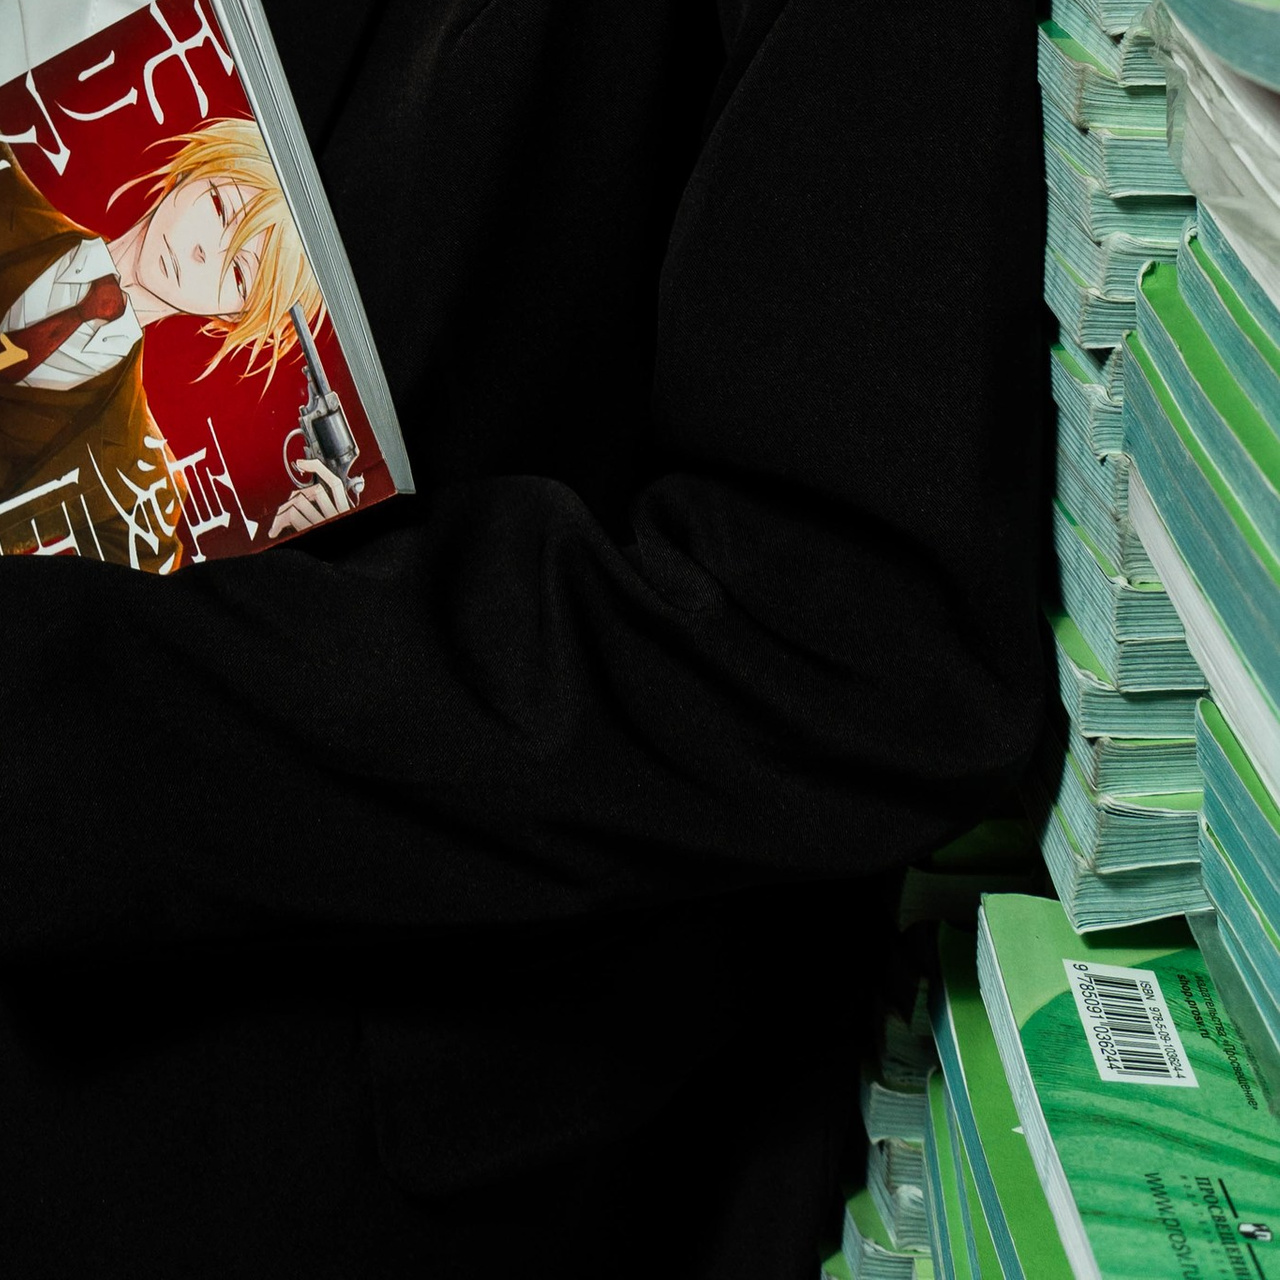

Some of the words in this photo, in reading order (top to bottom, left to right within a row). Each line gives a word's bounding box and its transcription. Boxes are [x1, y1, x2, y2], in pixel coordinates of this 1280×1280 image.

[1139, 980, 1156, 1002] ISBN
[1149, 1006, 1186, 1080] 978-5-09-103624-4
[1177, 974, 1210, 1039] shop.prosv.ru
[1194, 1176, 1253, 1280] ПРОСВЕЩЕНИ
